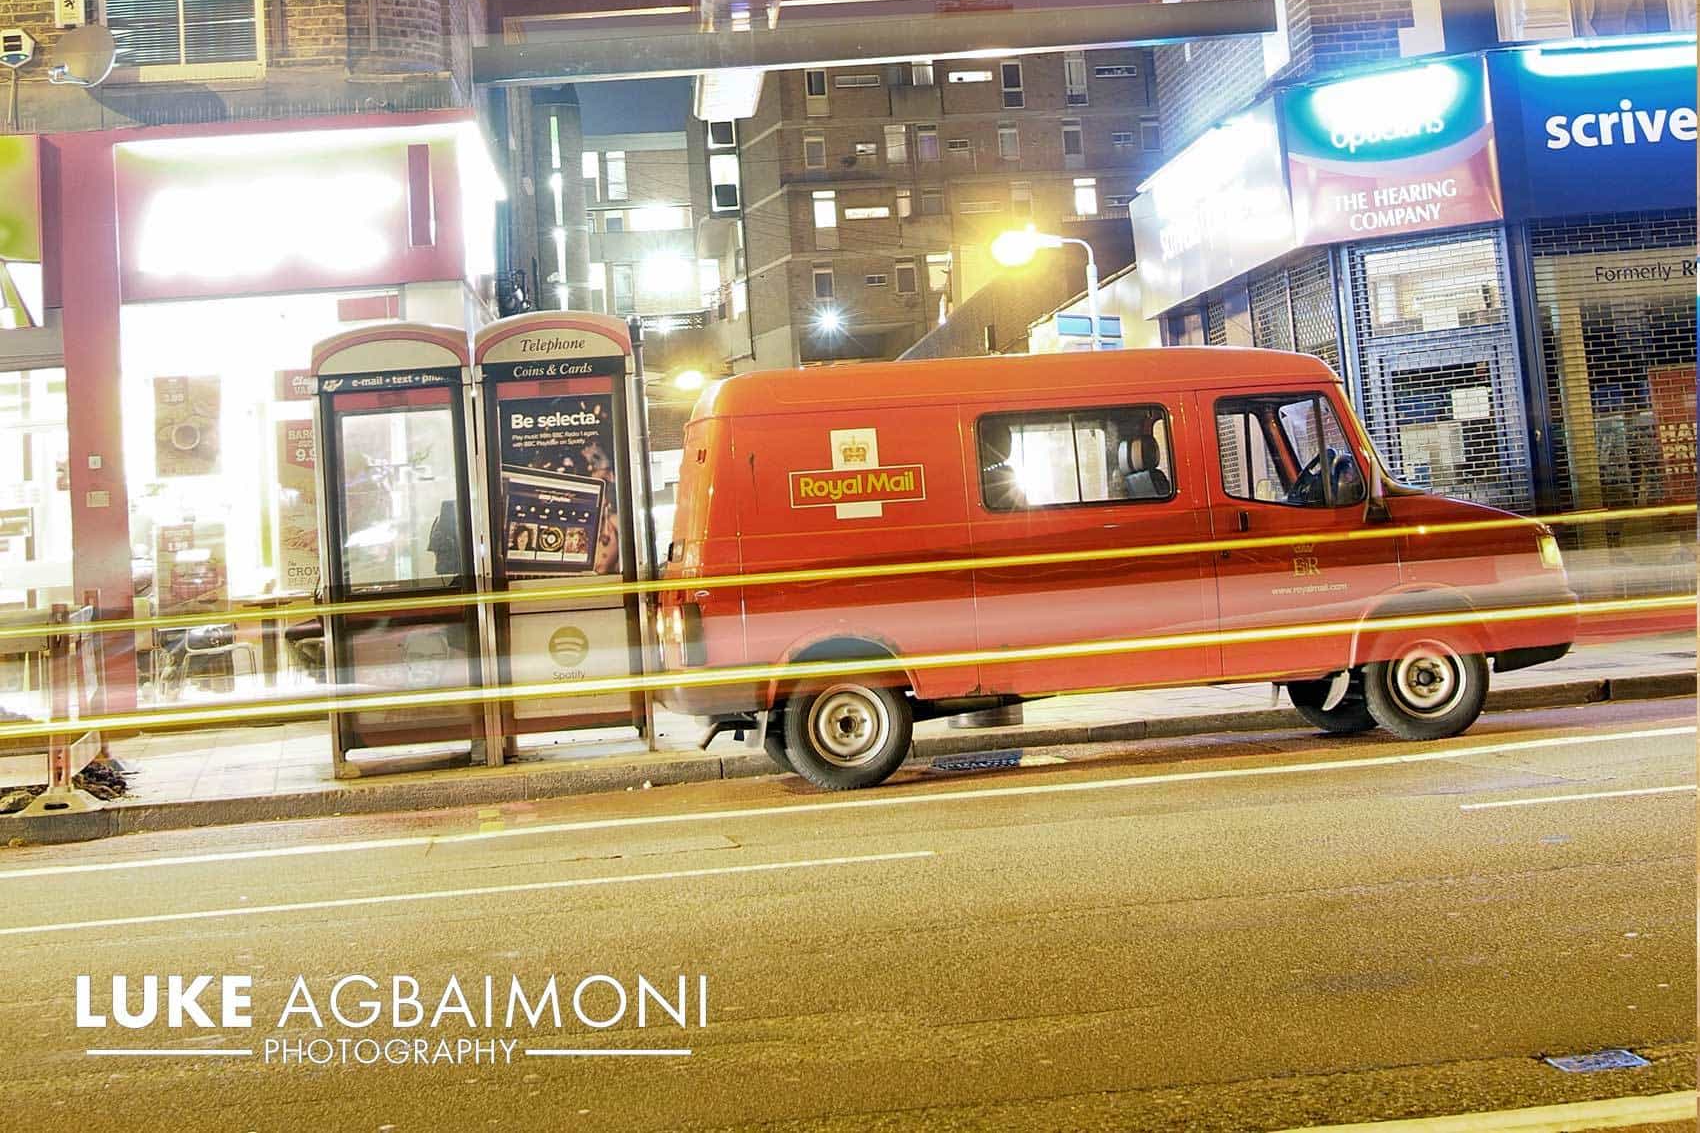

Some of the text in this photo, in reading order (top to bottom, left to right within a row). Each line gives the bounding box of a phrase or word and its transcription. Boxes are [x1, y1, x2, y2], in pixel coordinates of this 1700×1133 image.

[1545, 99, 1697, 149] scrive
[1335, 179, 1457, 212] THE HEARING
[1350, 202, 1443, 232] COMPANY
[1595, 262, 1672, 282] Formerly
[520, 338, 586, 353] Telephone
[513, 363, 593, 379] Coins & Cards
[351, 377, 384, 387] e-mail
[392, 375, 413, 385] text
[511, 411, 600, 429] Be selecta.
[799, 470, 915, 500] Royal Mail
[552, 669, 585, 682] Spotify
